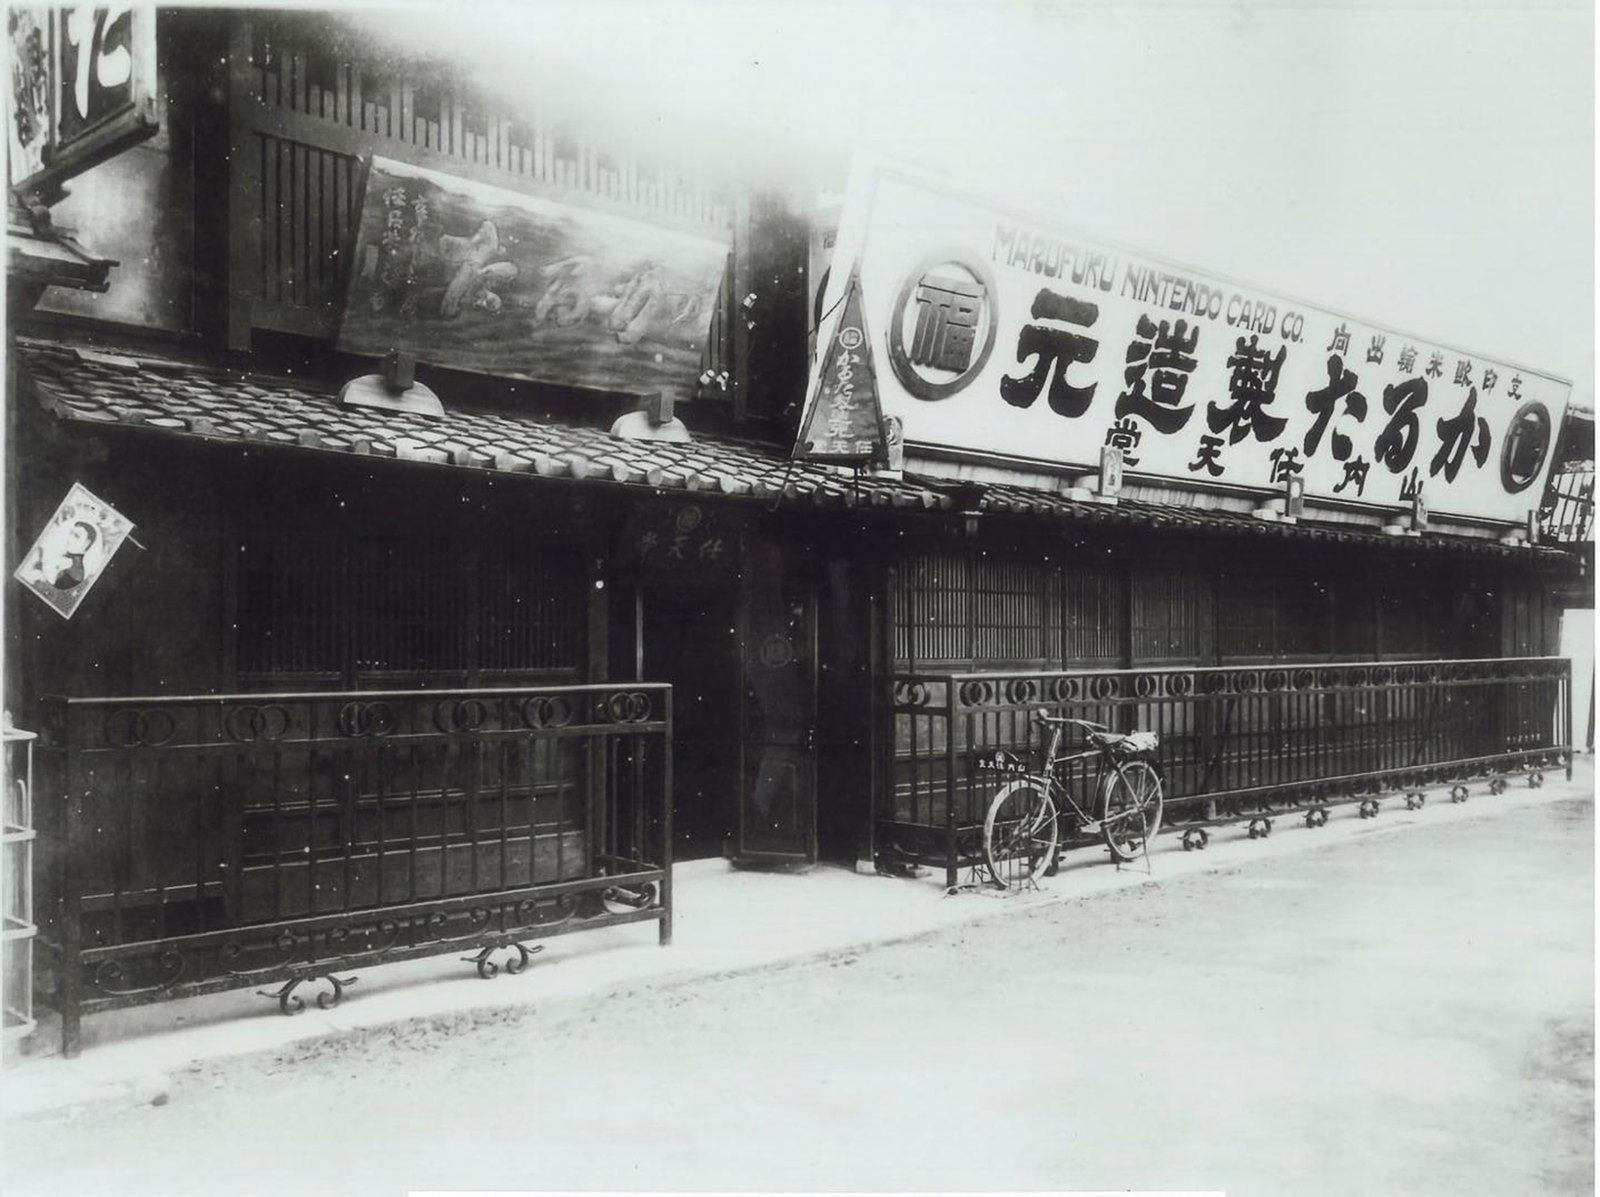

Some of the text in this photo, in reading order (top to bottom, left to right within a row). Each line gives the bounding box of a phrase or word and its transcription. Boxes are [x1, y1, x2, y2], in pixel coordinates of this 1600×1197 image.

[992, 224, 1118, 292] MARUFUKU
[1120, 263, 1224, 320] NINTENDO
[1226, 294, 1278, 345] CARD
